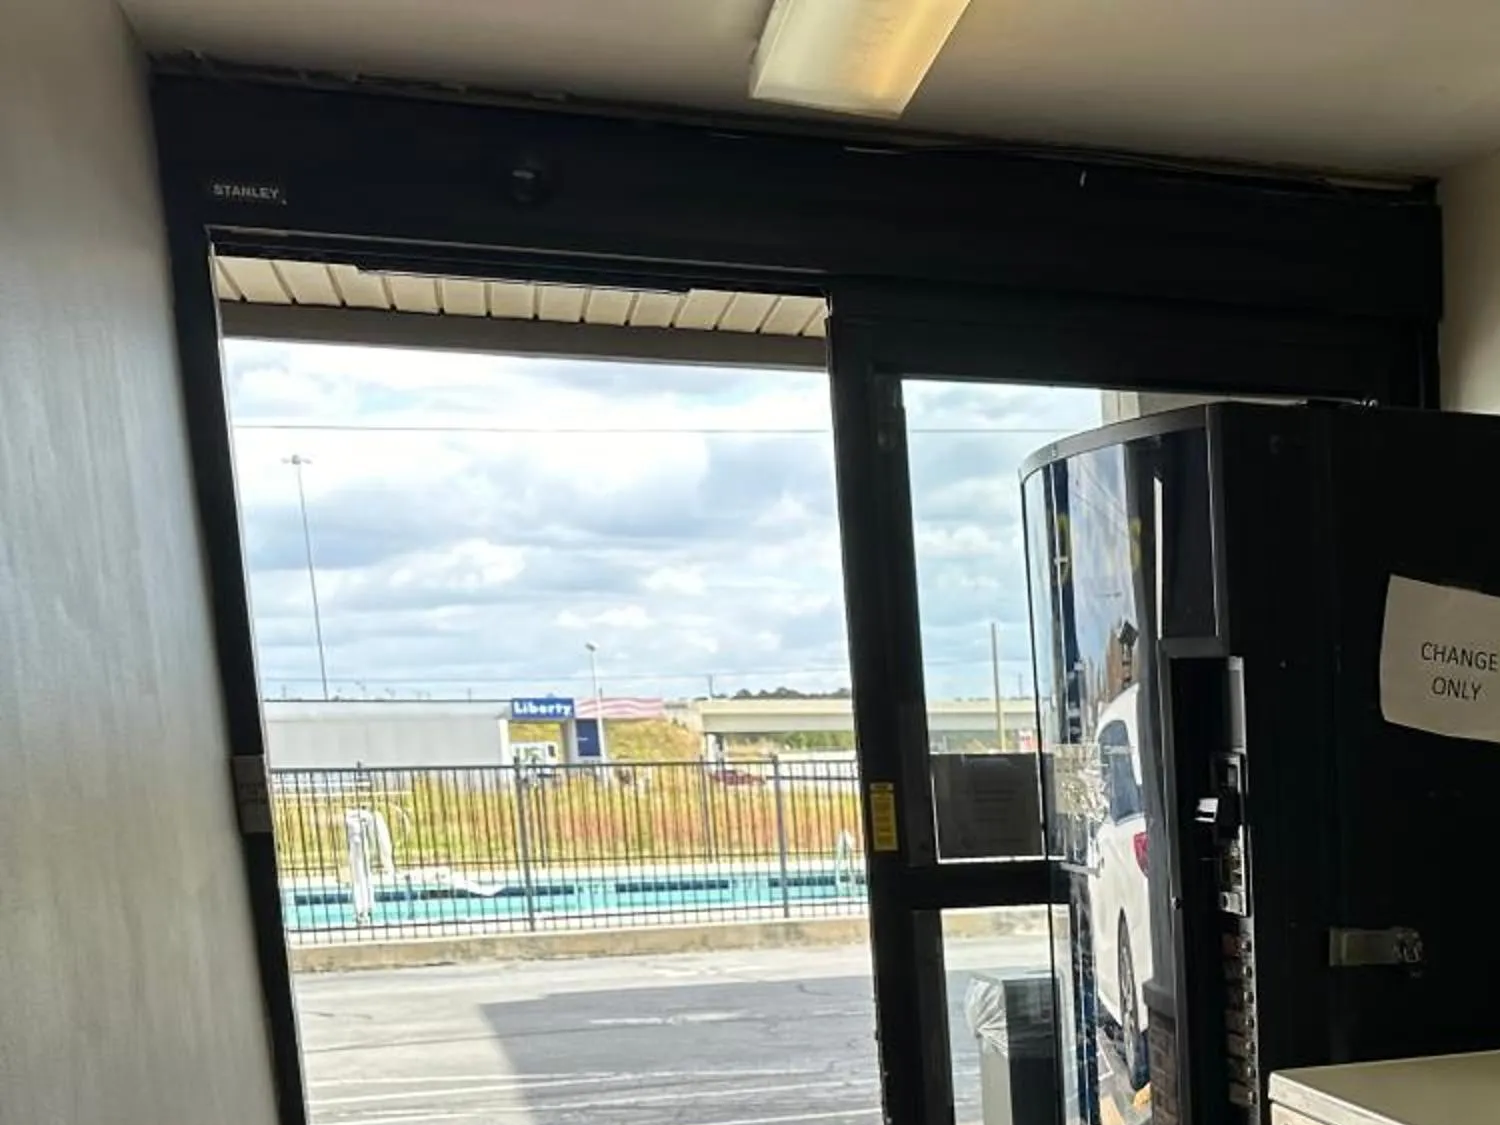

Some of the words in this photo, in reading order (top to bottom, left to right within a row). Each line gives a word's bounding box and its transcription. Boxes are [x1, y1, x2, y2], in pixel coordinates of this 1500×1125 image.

[213, 184, 279, 200] STANLEY
[1421, 641, 1499, 673] CHANGE
[1431, 676, 1482, 701] ONLY
[514, 701, 572, 716] Liberty
